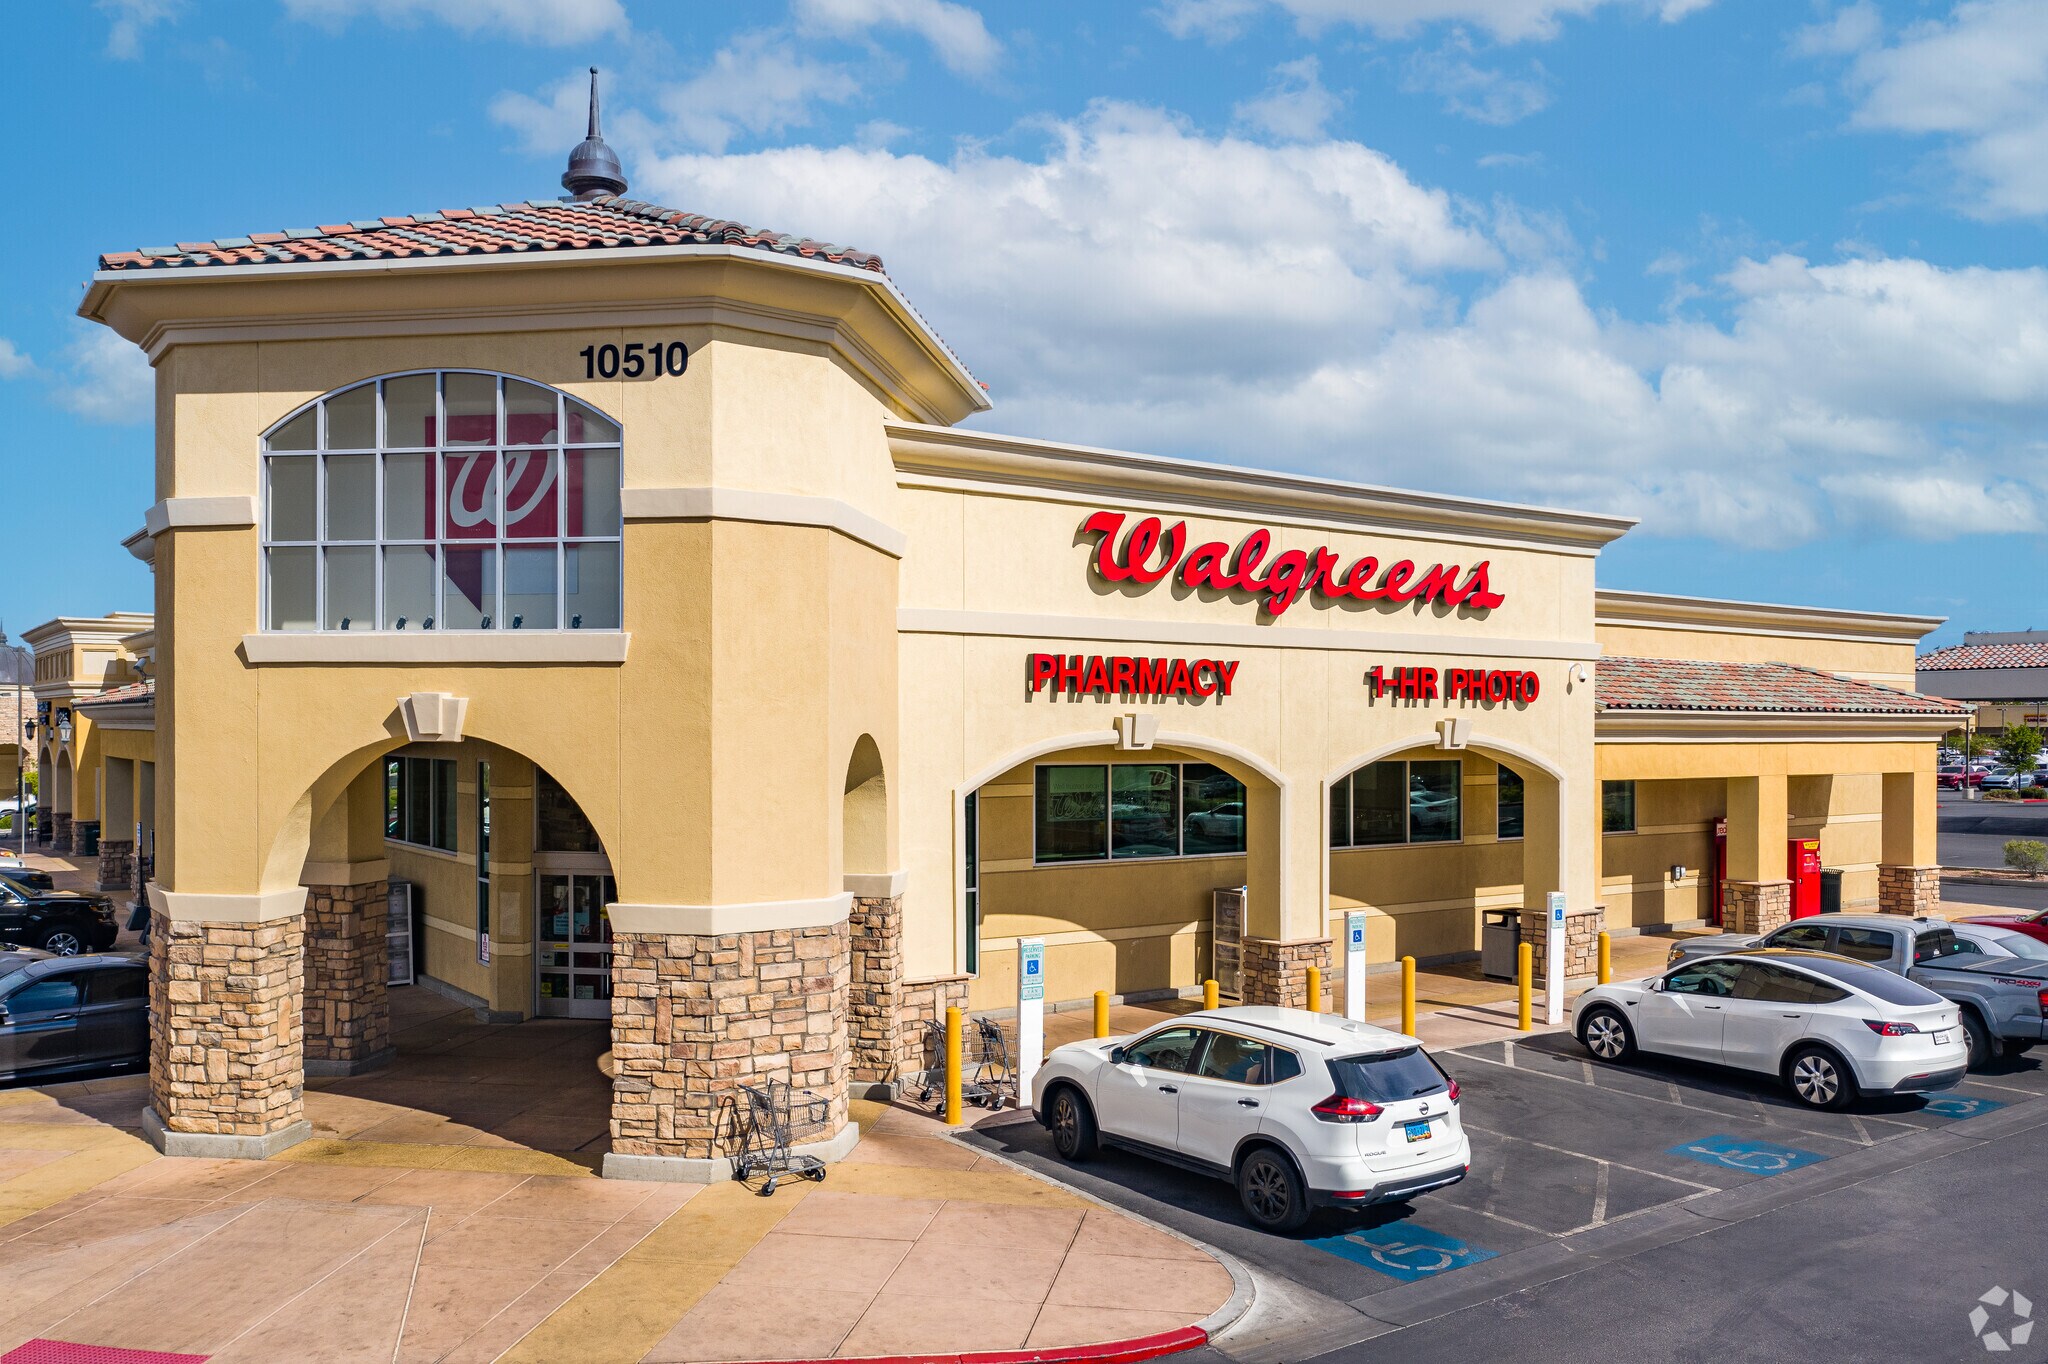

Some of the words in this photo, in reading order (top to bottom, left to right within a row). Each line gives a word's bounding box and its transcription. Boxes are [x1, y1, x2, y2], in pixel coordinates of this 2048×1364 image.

[580, 341, 688, 379] 10510
[1083, 511, 1505, 616] Walgreens
[1030, 653, 1240, 697] PHARMACY
[1370, 665, 1438, 699] 1-HR
[1450, 668, 1540, 703] PHOTO
[1991, 977, 2016, 985] TRD
